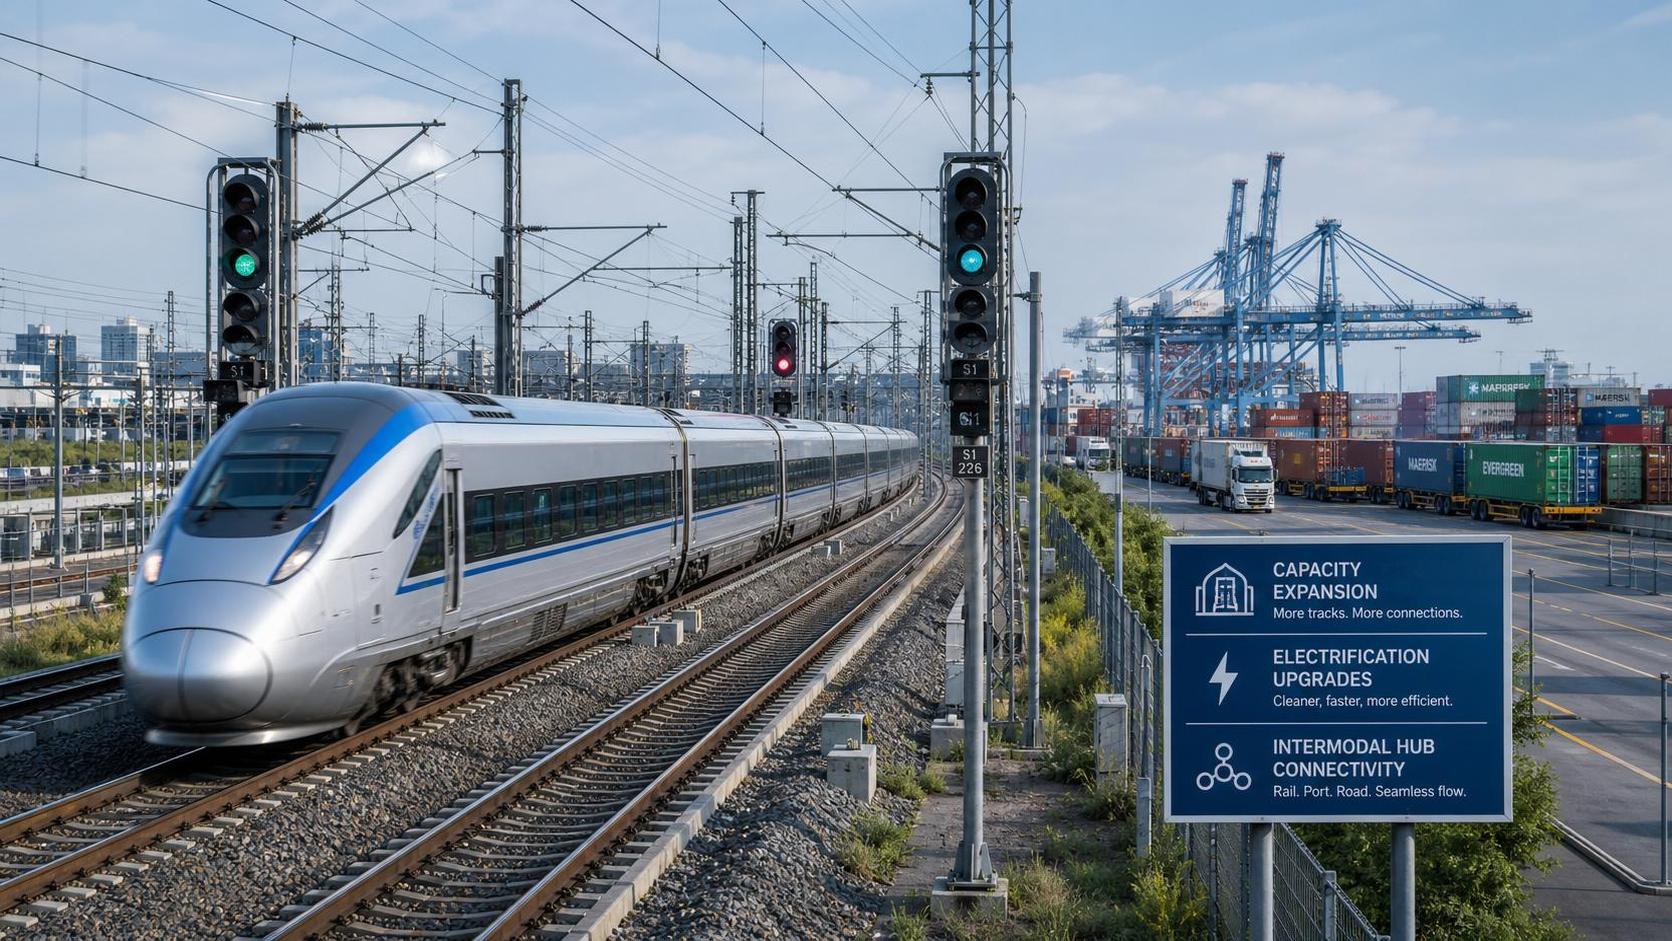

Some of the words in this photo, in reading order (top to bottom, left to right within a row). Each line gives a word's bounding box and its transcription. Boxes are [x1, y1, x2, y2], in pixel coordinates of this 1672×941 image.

[962, 364, 978, 375] S1
[962, 449, 977, 460] S1
[958, 463, 983, 475] 226
[1482, 460, 1525, 478] EVERGREEN
[1273, 561, 1362, 578] CAPACITY
[1273, 584, 1378, 600] EXPANSION
[1273, 607, 1305, 619] More
[1307, 607, 1349, 619] tracks.
[1352, 607, 1384, 619] More
[1386, 607, 1464, 619] connections.
[1273, 648, 1430, 665] ELECTRIFICATION
[1273, 671, 1373, 687] UPGRADES
[1273, 694, 1323, 708] Cleaner,
[1326, 694, 1364, 708] faster,
[1366, 697, 1398, 707] more
[1401, 694, 1454, 707] efficient.
[1273, 738, 1392, 755] INTERMODAL
[1396, 738, 1436, 754] HUB
[1273, 761, 1406, 778] CONNECTIVITY
[1273, 785, 1300, 798] Rail.
[1303, 785, 1333, 798] Port.
[1336, 785, 1373, 798] Road.
[1375, 785, 1435, 797] Seamless
[1437, 785, 1467, 797] flow.
